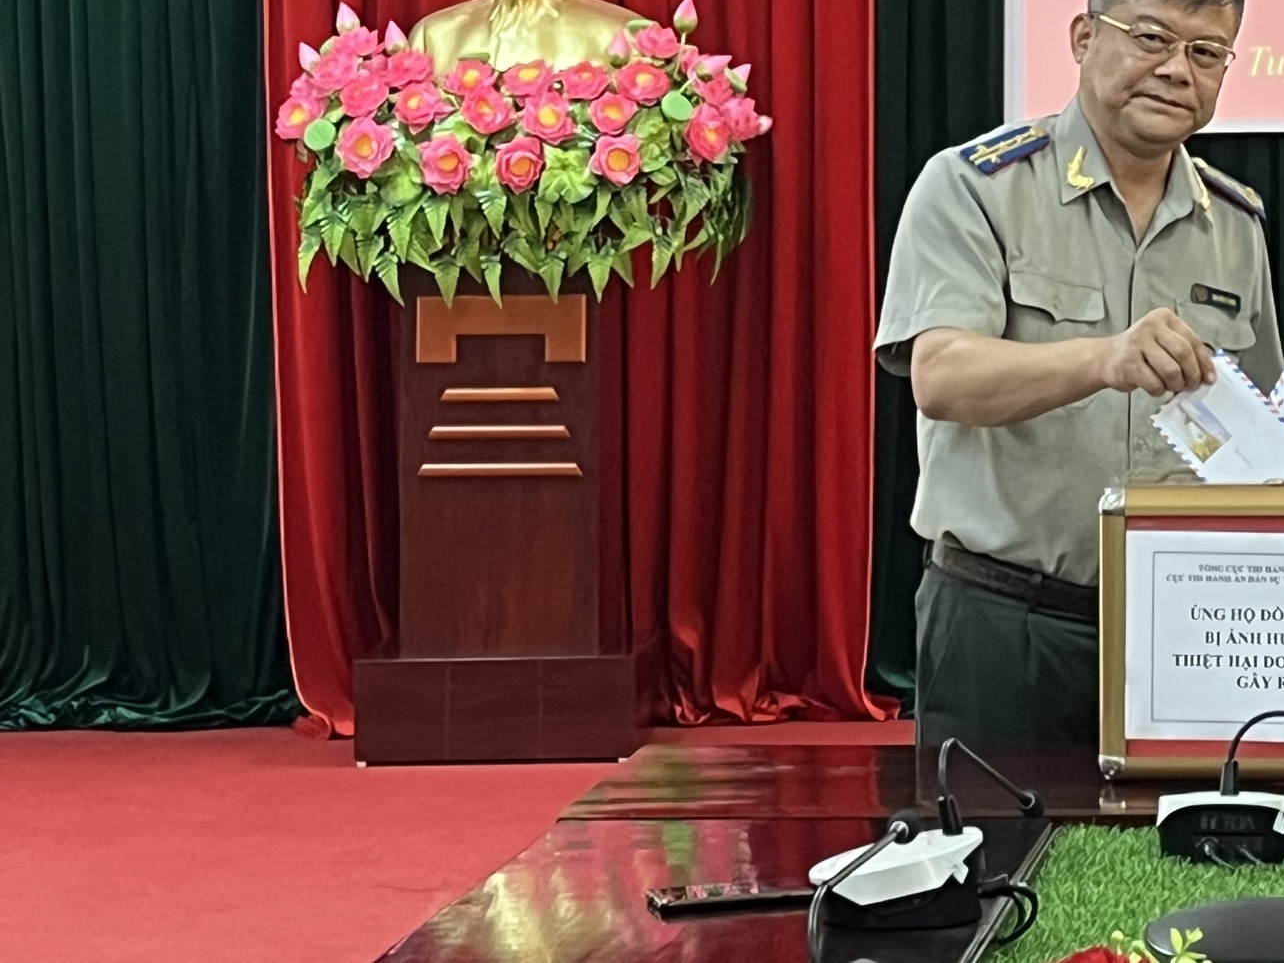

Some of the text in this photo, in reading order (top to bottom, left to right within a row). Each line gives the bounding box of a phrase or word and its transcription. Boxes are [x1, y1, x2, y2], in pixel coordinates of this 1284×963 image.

[1230, 607, 1256, 625] HỌ
[1205, 631, 1221, 646] BỊ
[1226, 627, 1262, 645] ẢNH
[1172, 653, 1223, 670] THIỆT
[1228, 654, 1258, 671] HẠI
[1236, 672, 1273, 689] GÂY
